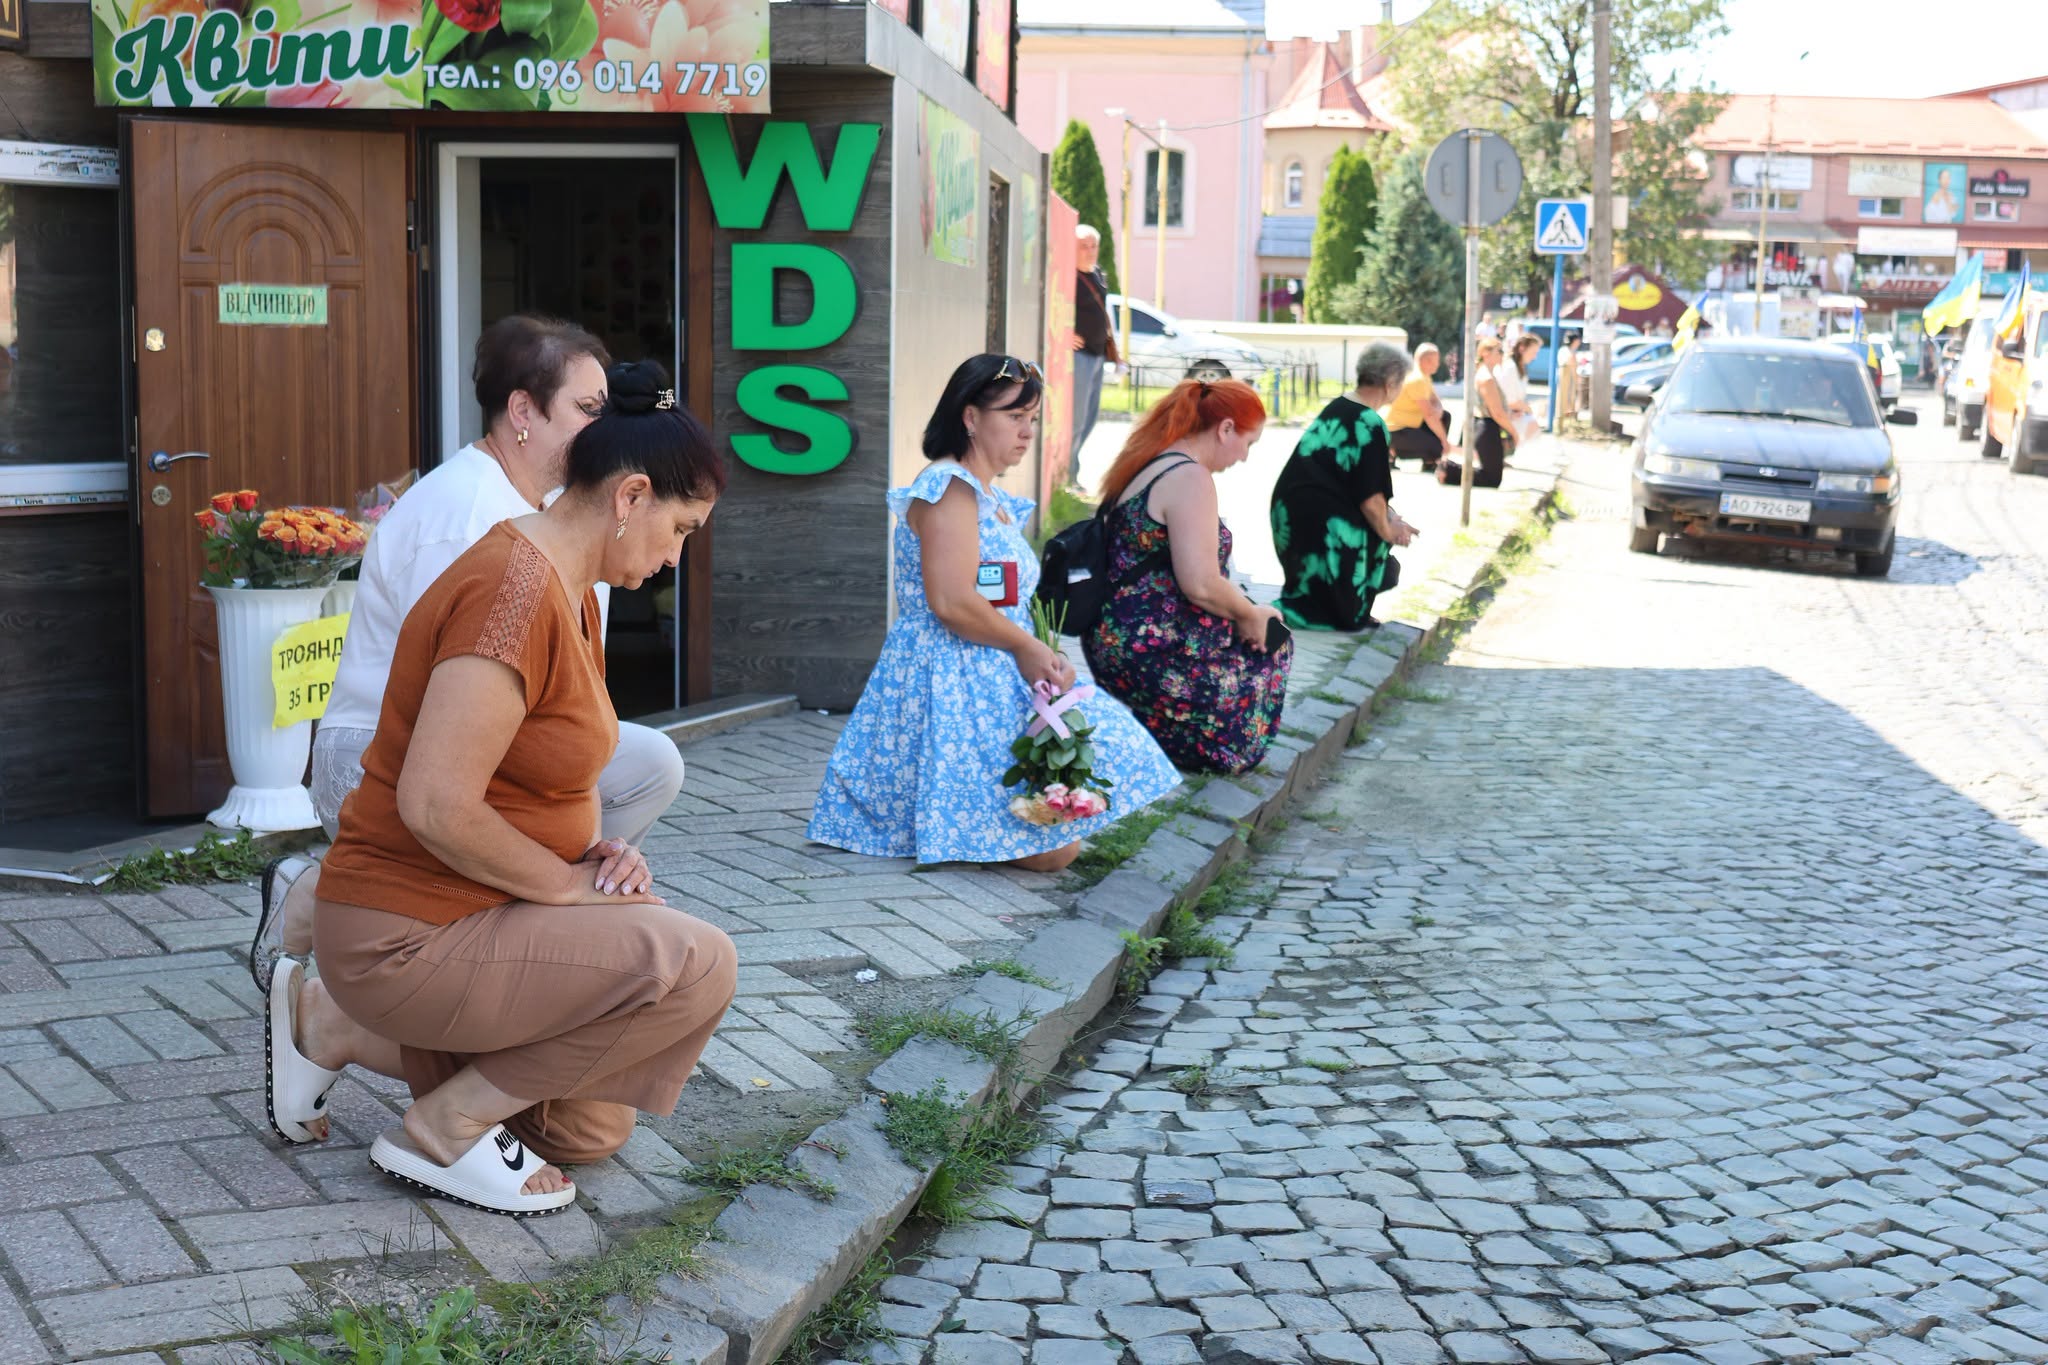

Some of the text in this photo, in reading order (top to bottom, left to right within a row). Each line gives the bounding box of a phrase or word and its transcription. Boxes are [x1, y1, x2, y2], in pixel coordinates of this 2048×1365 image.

[114, 8, 421, 108] Квіти
[422, 58, 767, 96] тел.: 096 014 7719
[684, 113, 883, 475] WDS
[289, 681, 335, 710] 35 ГР
[494, 1129, 518, 1154] NIK
